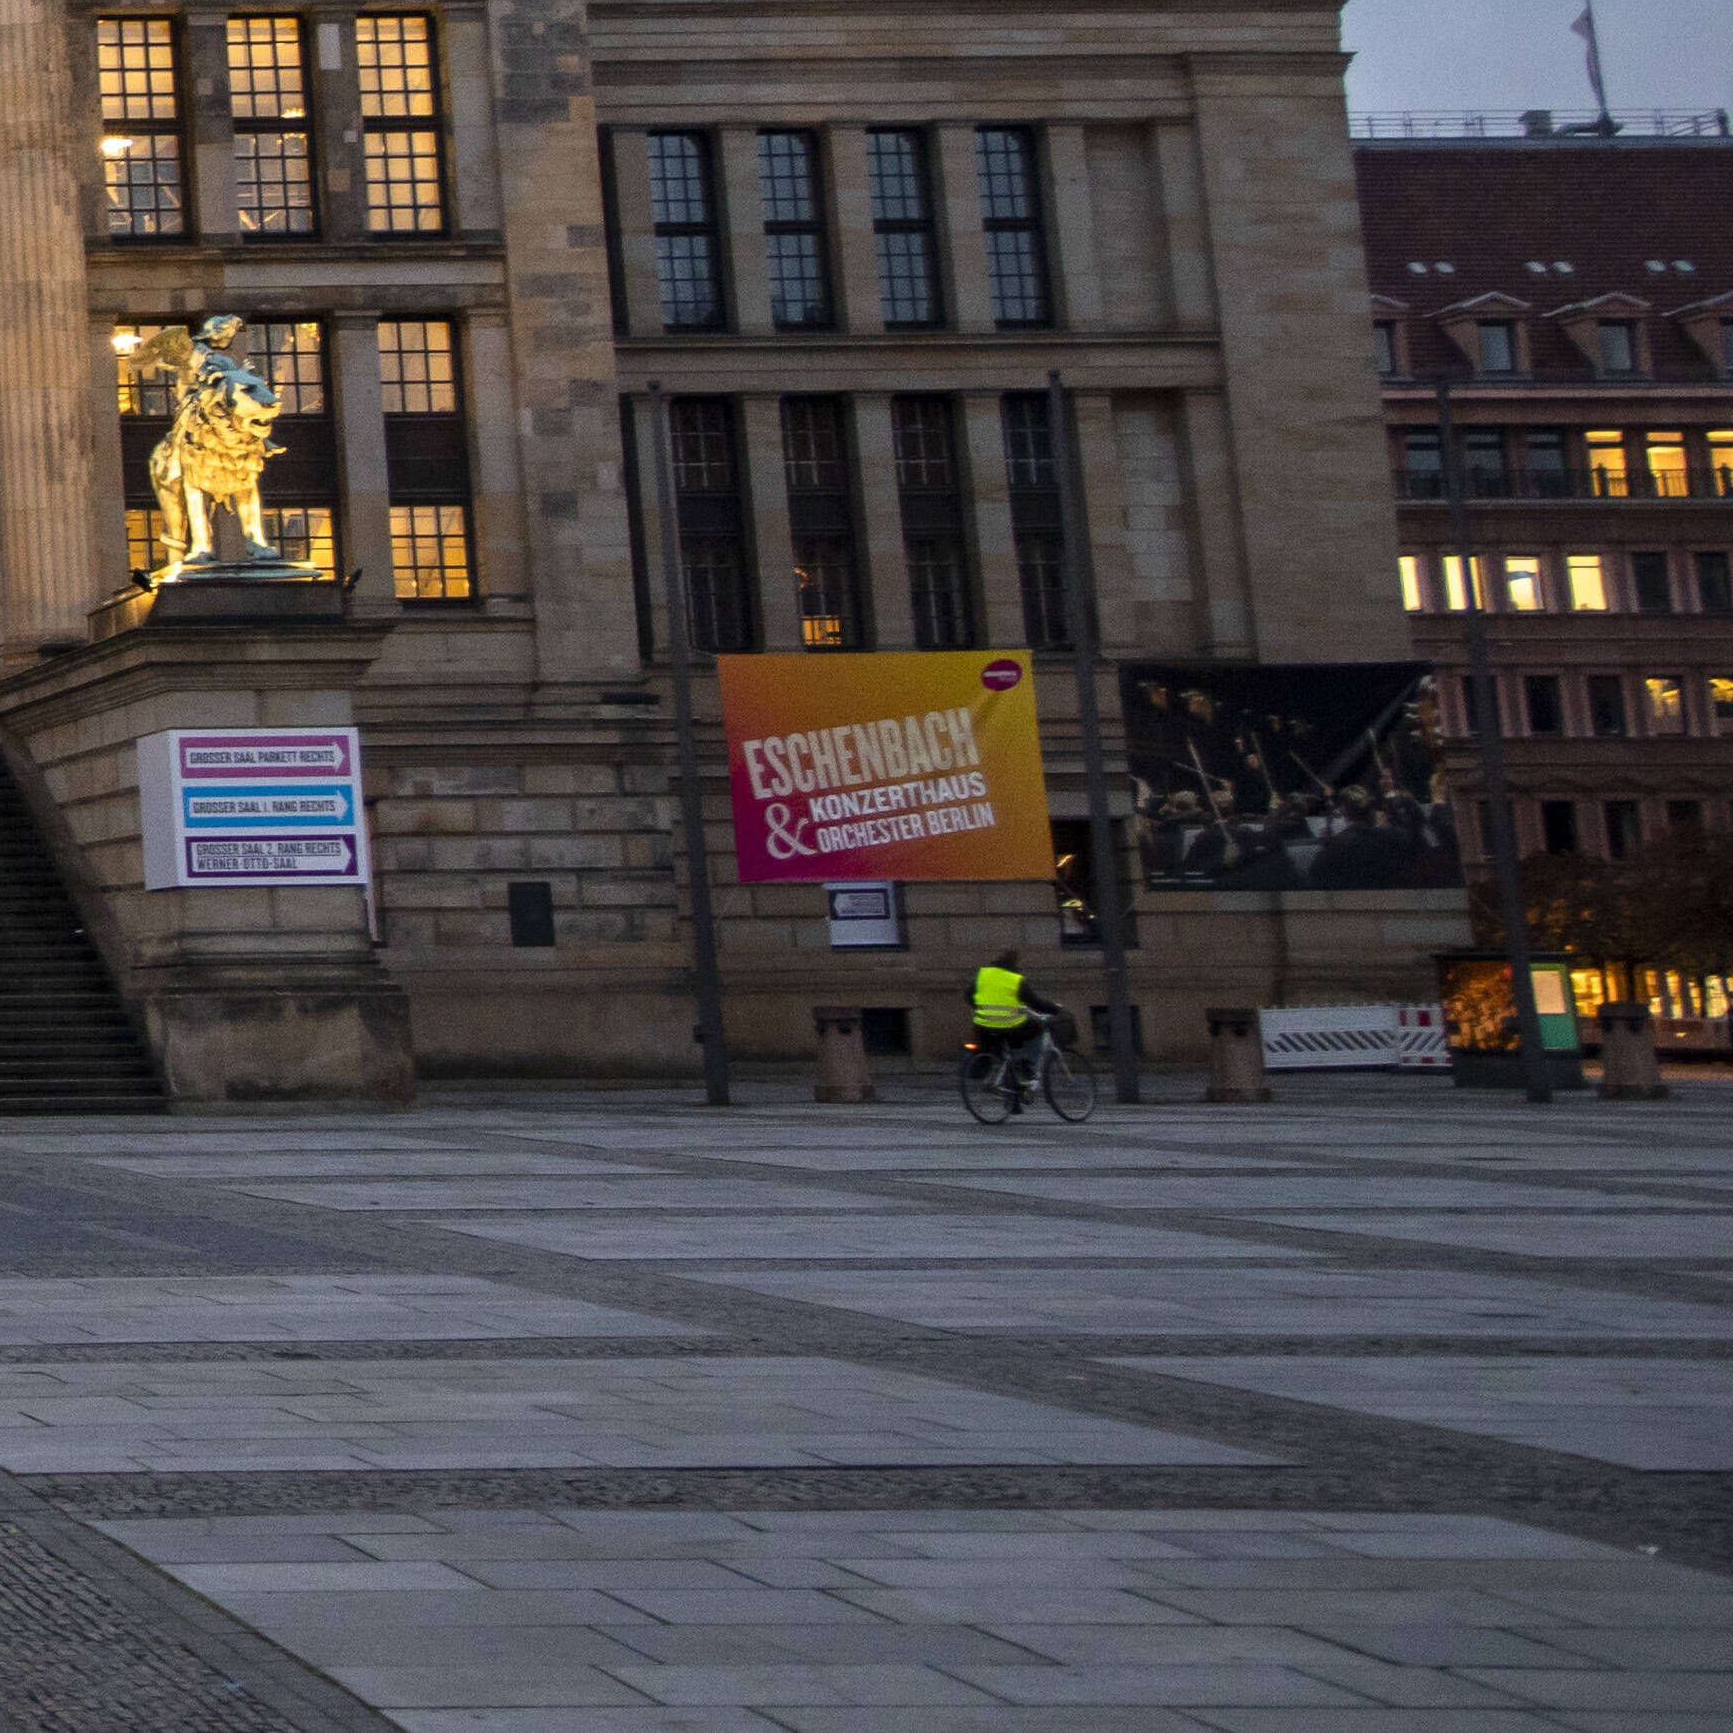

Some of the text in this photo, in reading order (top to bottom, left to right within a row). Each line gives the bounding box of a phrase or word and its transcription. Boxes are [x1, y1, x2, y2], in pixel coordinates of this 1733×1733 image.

[190, 751, 335, 764] GROSSER SAAL PARKETT RECHTS
[742, 707, 979, 800] ESCHENBACH
[193, 802, 236, 814] GROSSER
[238, 802, 261, 813] SAAL
[272, 801, 297, 812] RANG
[300, 801, 335, 812] RECHTS
[765, 771, 986, 859] & KONZERTHAUS
[816, 802, 996, 853] ORCHESTER BERLIN
[197, 843, 240, 855] GROSSER
[242, 843, 265, 854] SAAL
[278, 843, 302, 854] RANG
[306, 842, 341, 853] RECHTS
[198, 858, 298, 869] WERNER-OTTO-SAAL
